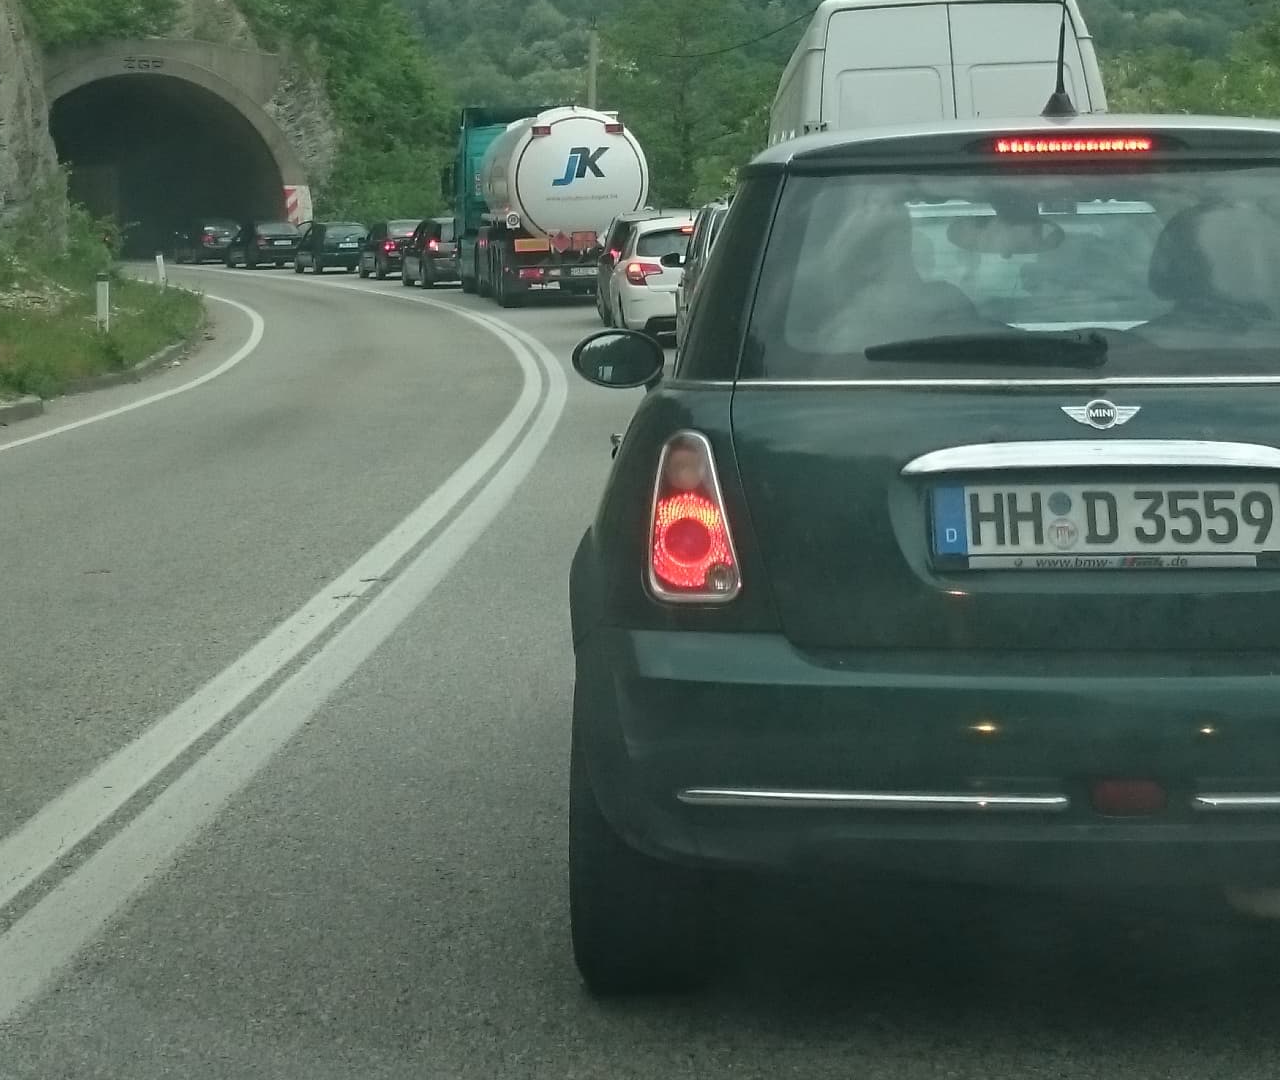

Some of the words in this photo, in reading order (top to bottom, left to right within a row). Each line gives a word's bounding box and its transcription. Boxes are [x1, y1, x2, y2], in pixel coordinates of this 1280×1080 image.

[551, 146, 610, 187] JK
[1089, 408, 1114, 418] MINI
[970, 492, 1044, 546] HH
[1082, 491, 1119, 545] D
[1134, 491, 1274, 545] 3559
[945, 527, 958, 543] D
